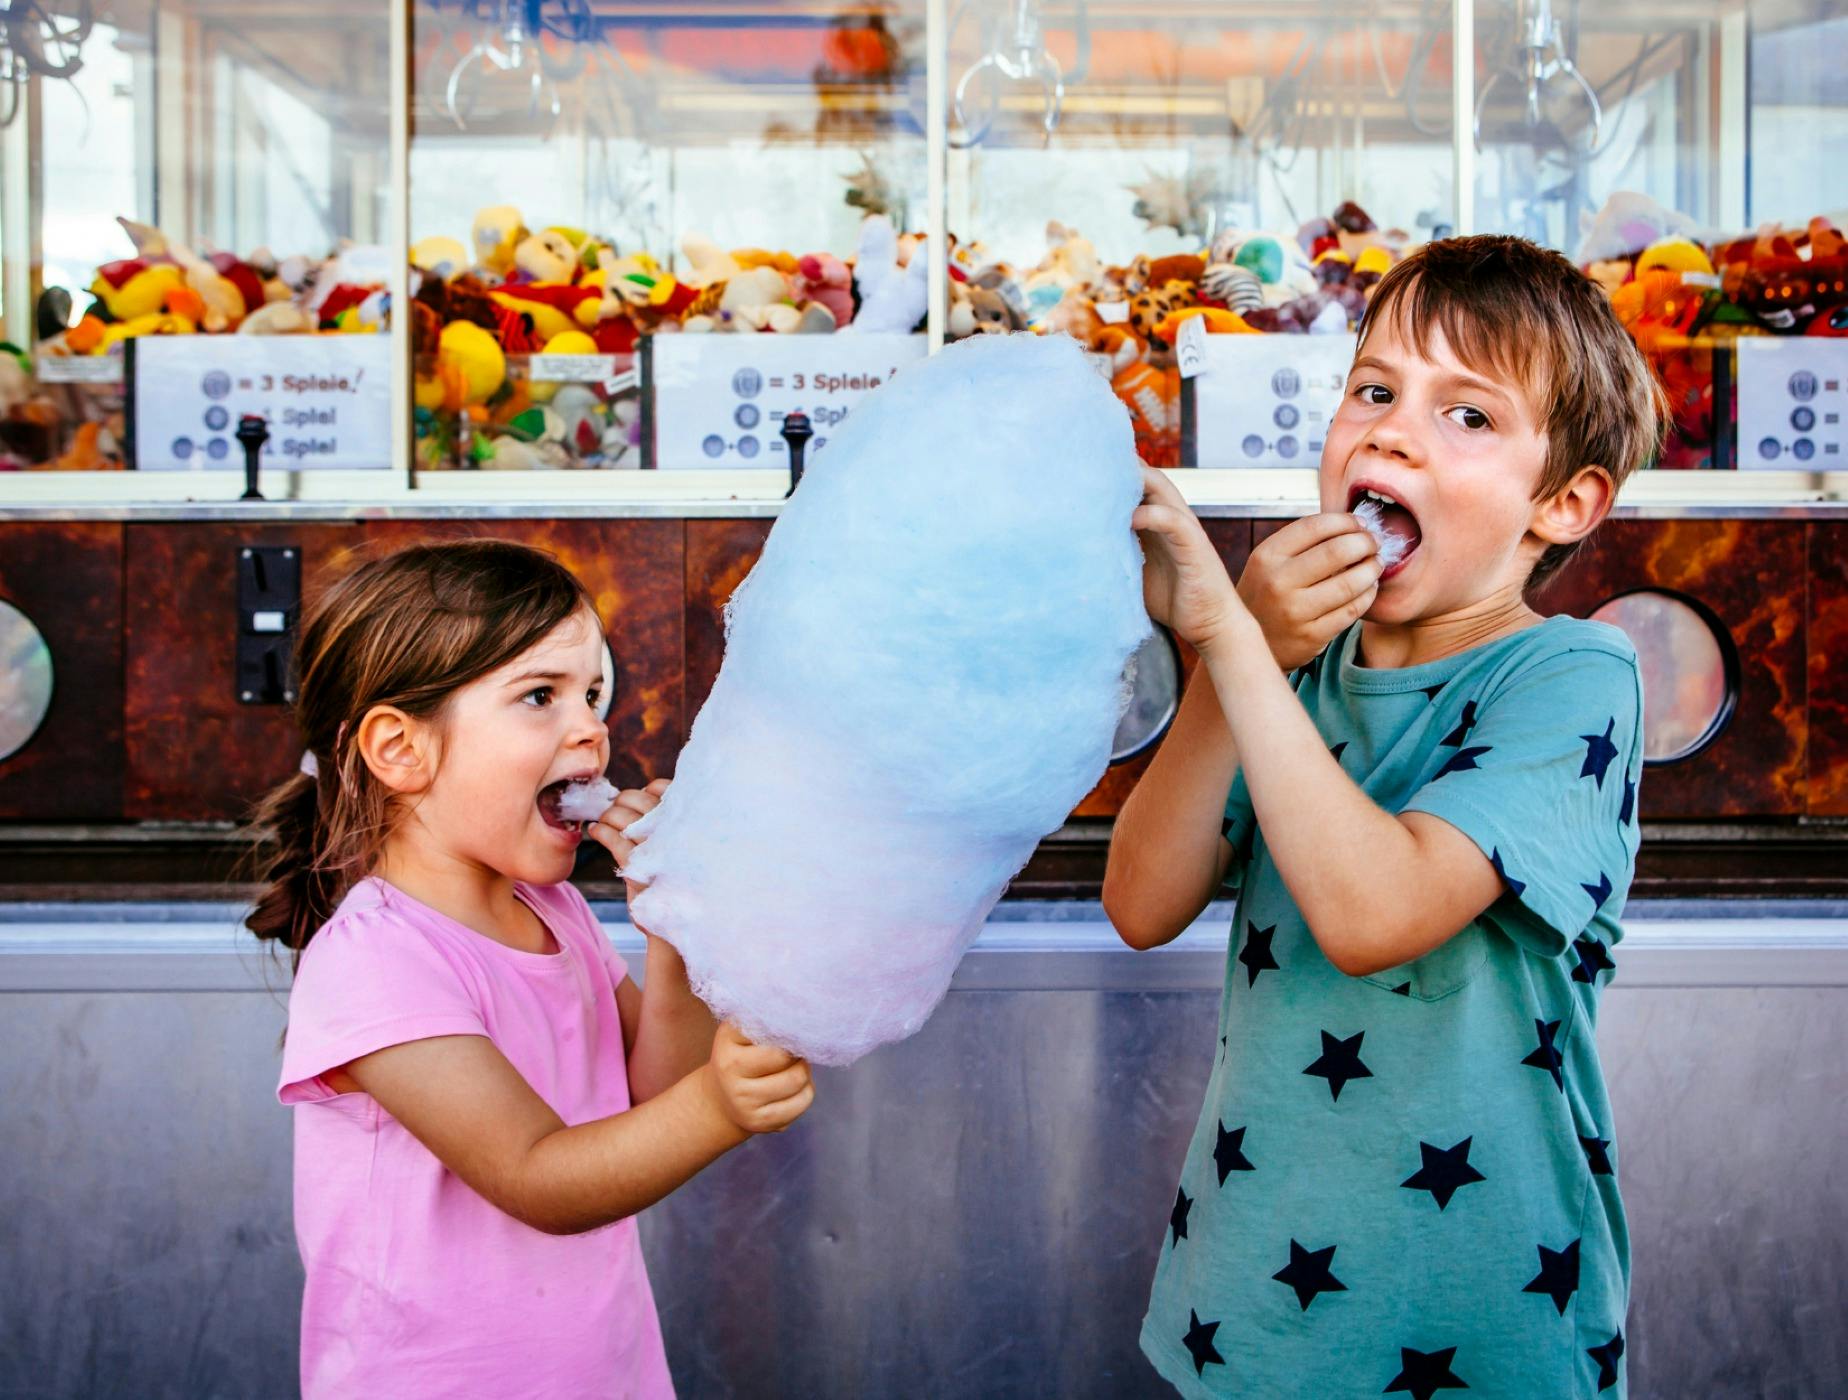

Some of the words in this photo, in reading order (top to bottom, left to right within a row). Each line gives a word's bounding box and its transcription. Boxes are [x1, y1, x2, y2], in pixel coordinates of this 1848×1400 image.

[261, 374, 273, 391] 3
[793, 374, 805, 391] 3
[1331, 374, 1343, 391] 3
[282, 407, 336, 429] Spiel
[282, 438, 336, 459] Spiel
